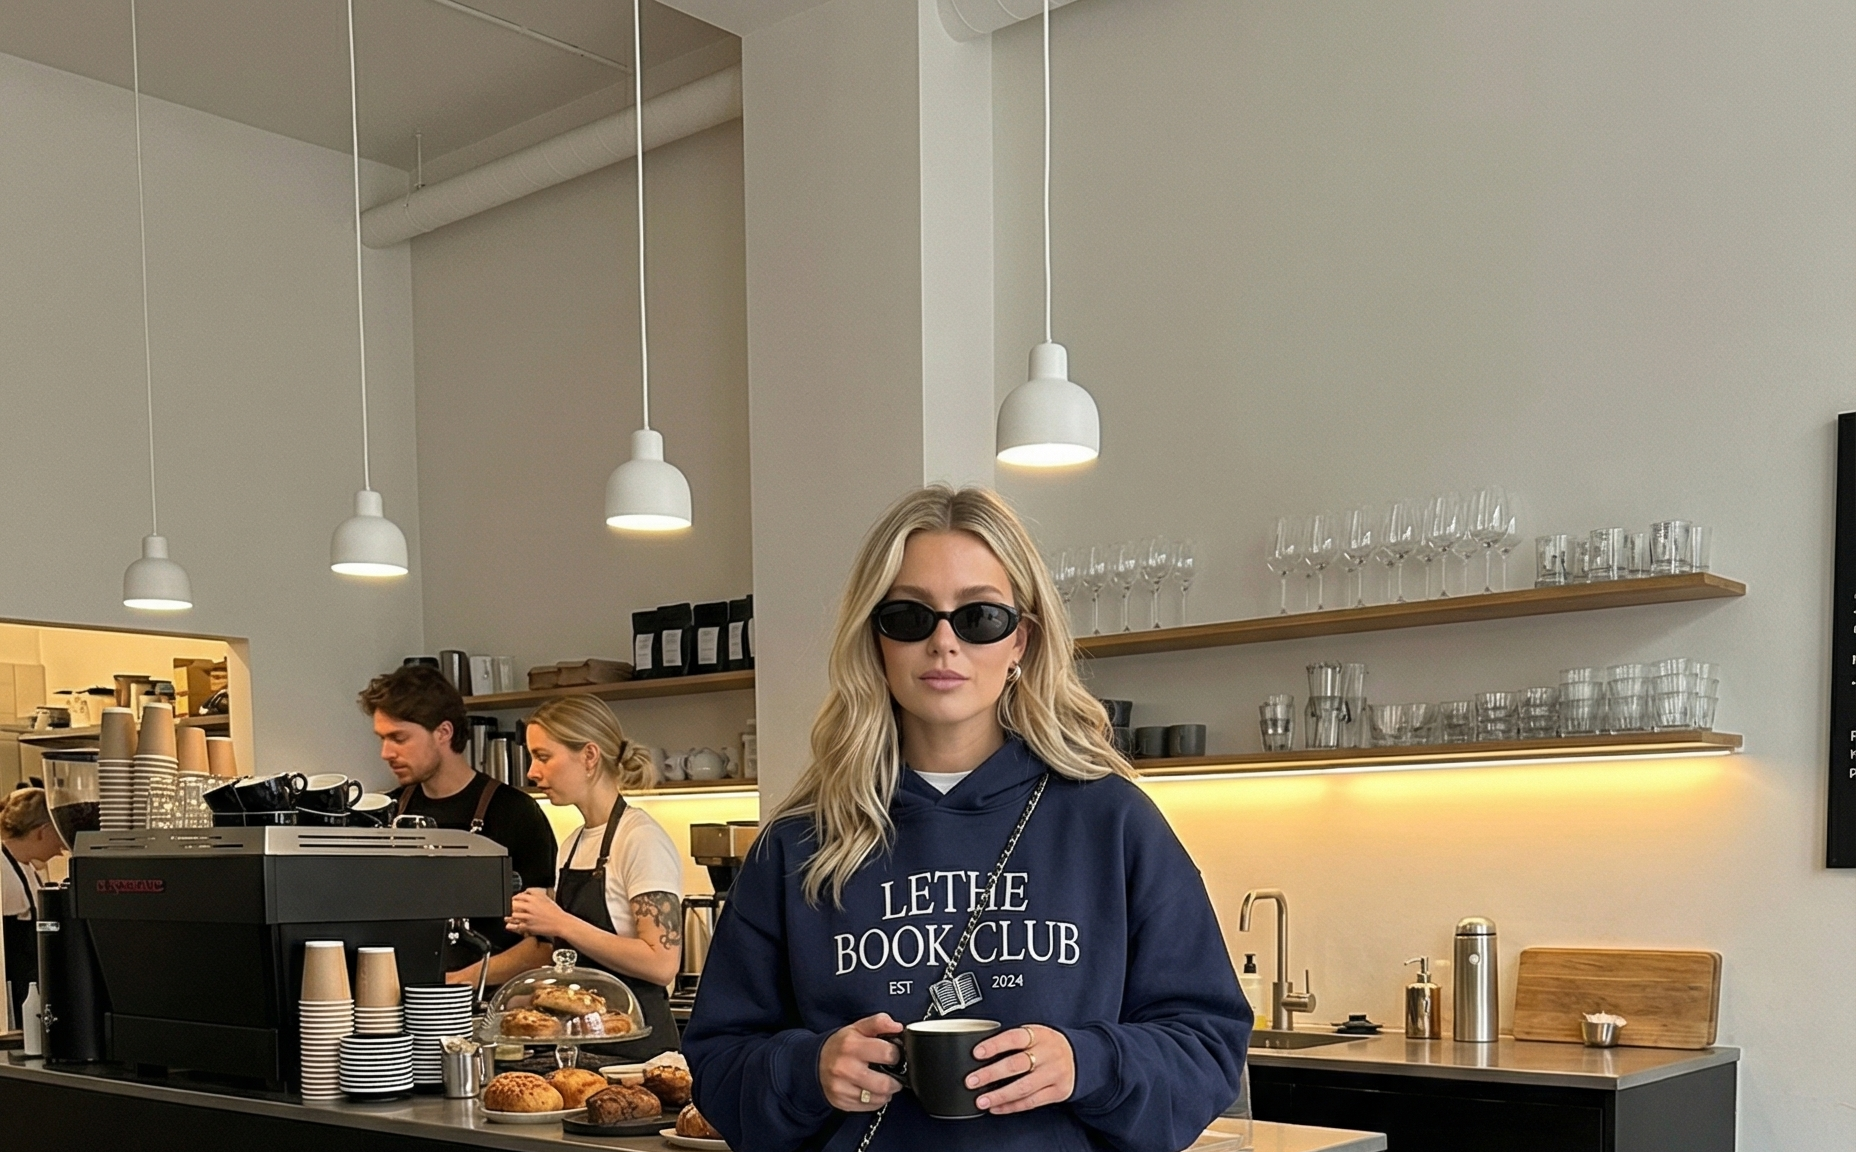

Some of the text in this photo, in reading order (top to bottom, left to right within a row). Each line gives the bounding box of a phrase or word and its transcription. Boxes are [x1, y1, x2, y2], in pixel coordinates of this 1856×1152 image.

[881, 871, 1029, 920] LETHE
[834, 920, 1080, 975] BOOK CLUB
[889, 974, 1023, 994] EST 2024
